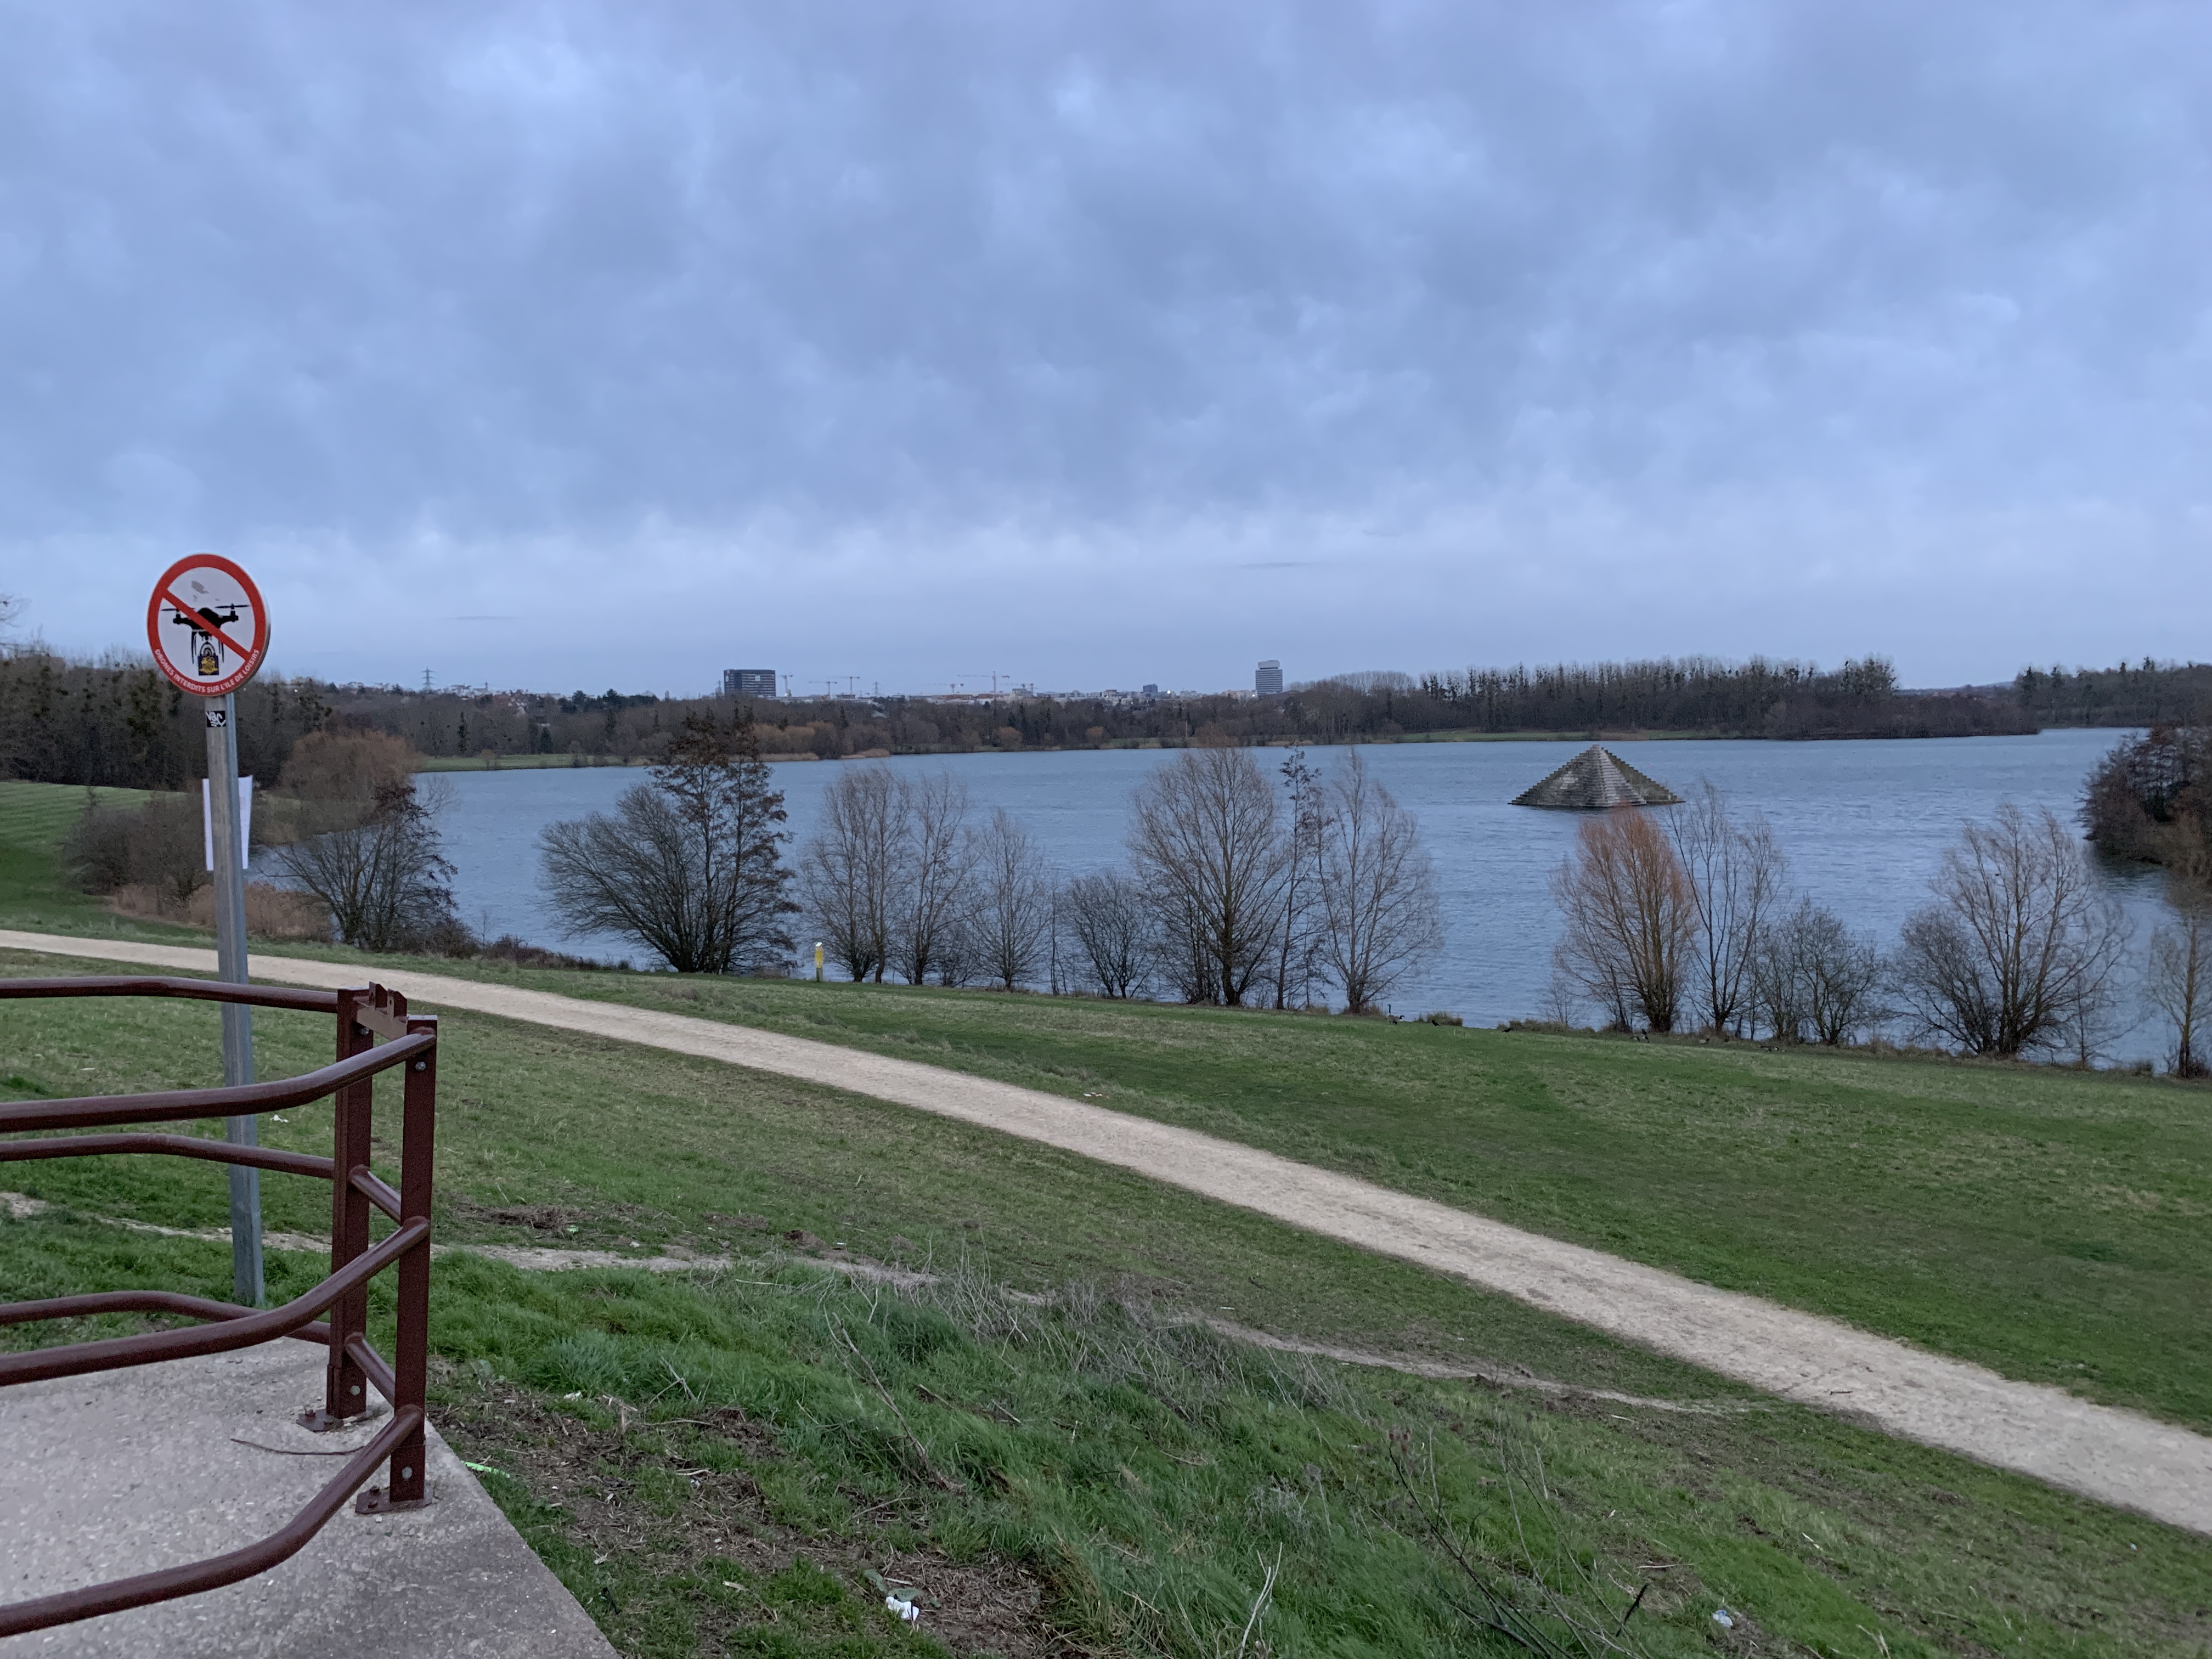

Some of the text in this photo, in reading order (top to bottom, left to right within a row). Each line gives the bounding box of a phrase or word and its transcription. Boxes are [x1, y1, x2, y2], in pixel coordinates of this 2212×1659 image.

[155, 649, 175, 675] DRONES
[173, 673, 206, 692] INTERDITS
[207, 685, 220, 693] SUR
[234, 672, 244, 682] DE
[242, 649, 259, 675] LOISIRS
